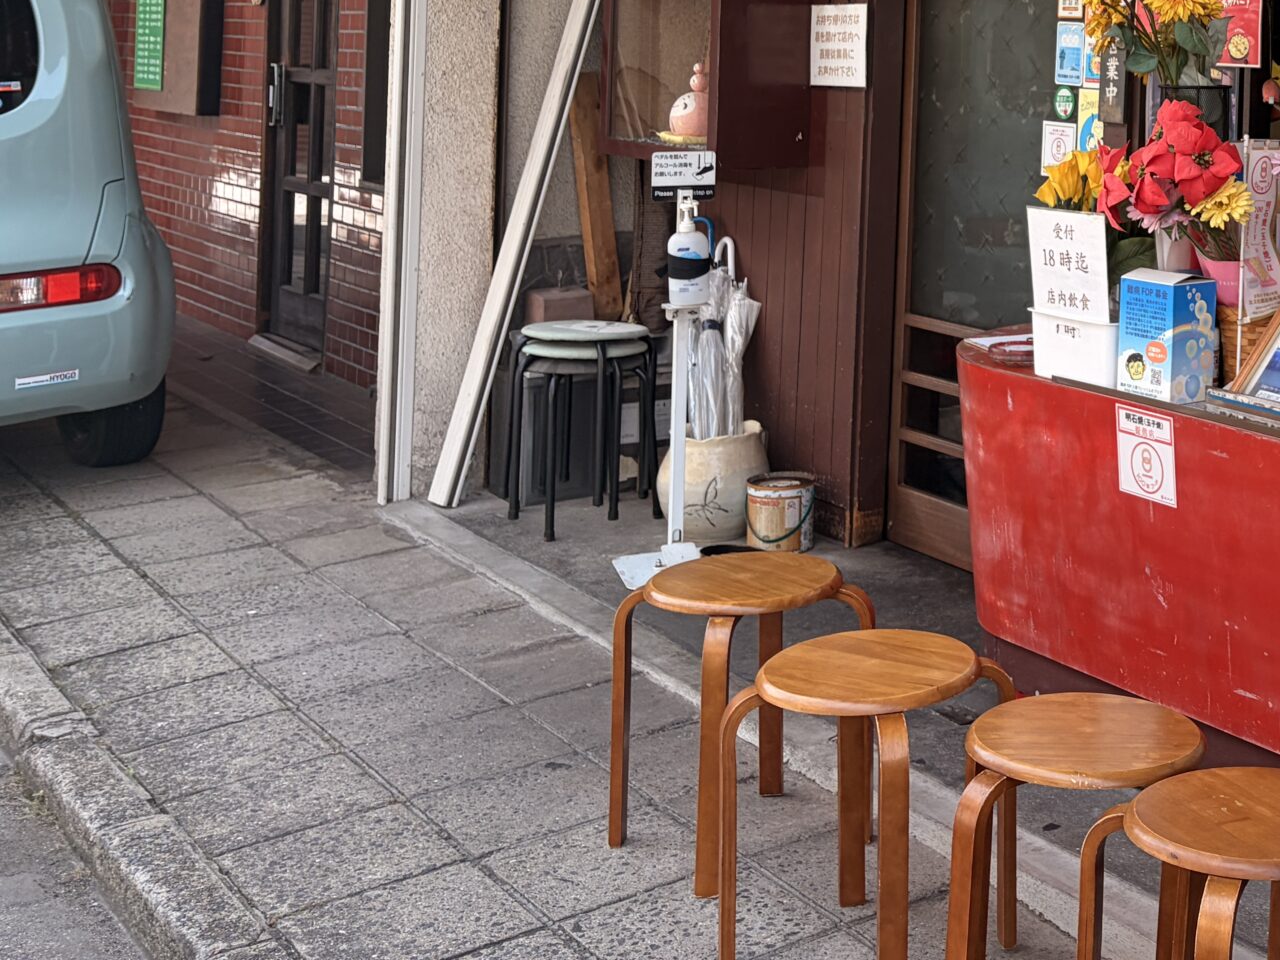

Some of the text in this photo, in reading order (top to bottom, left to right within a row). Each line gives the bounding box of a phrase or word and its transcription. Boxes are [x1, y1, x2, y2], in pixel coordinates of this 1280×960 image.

[1052, 222, 1075, 241] 受付
[1047, 288, 1091, 311] 店内飲食
